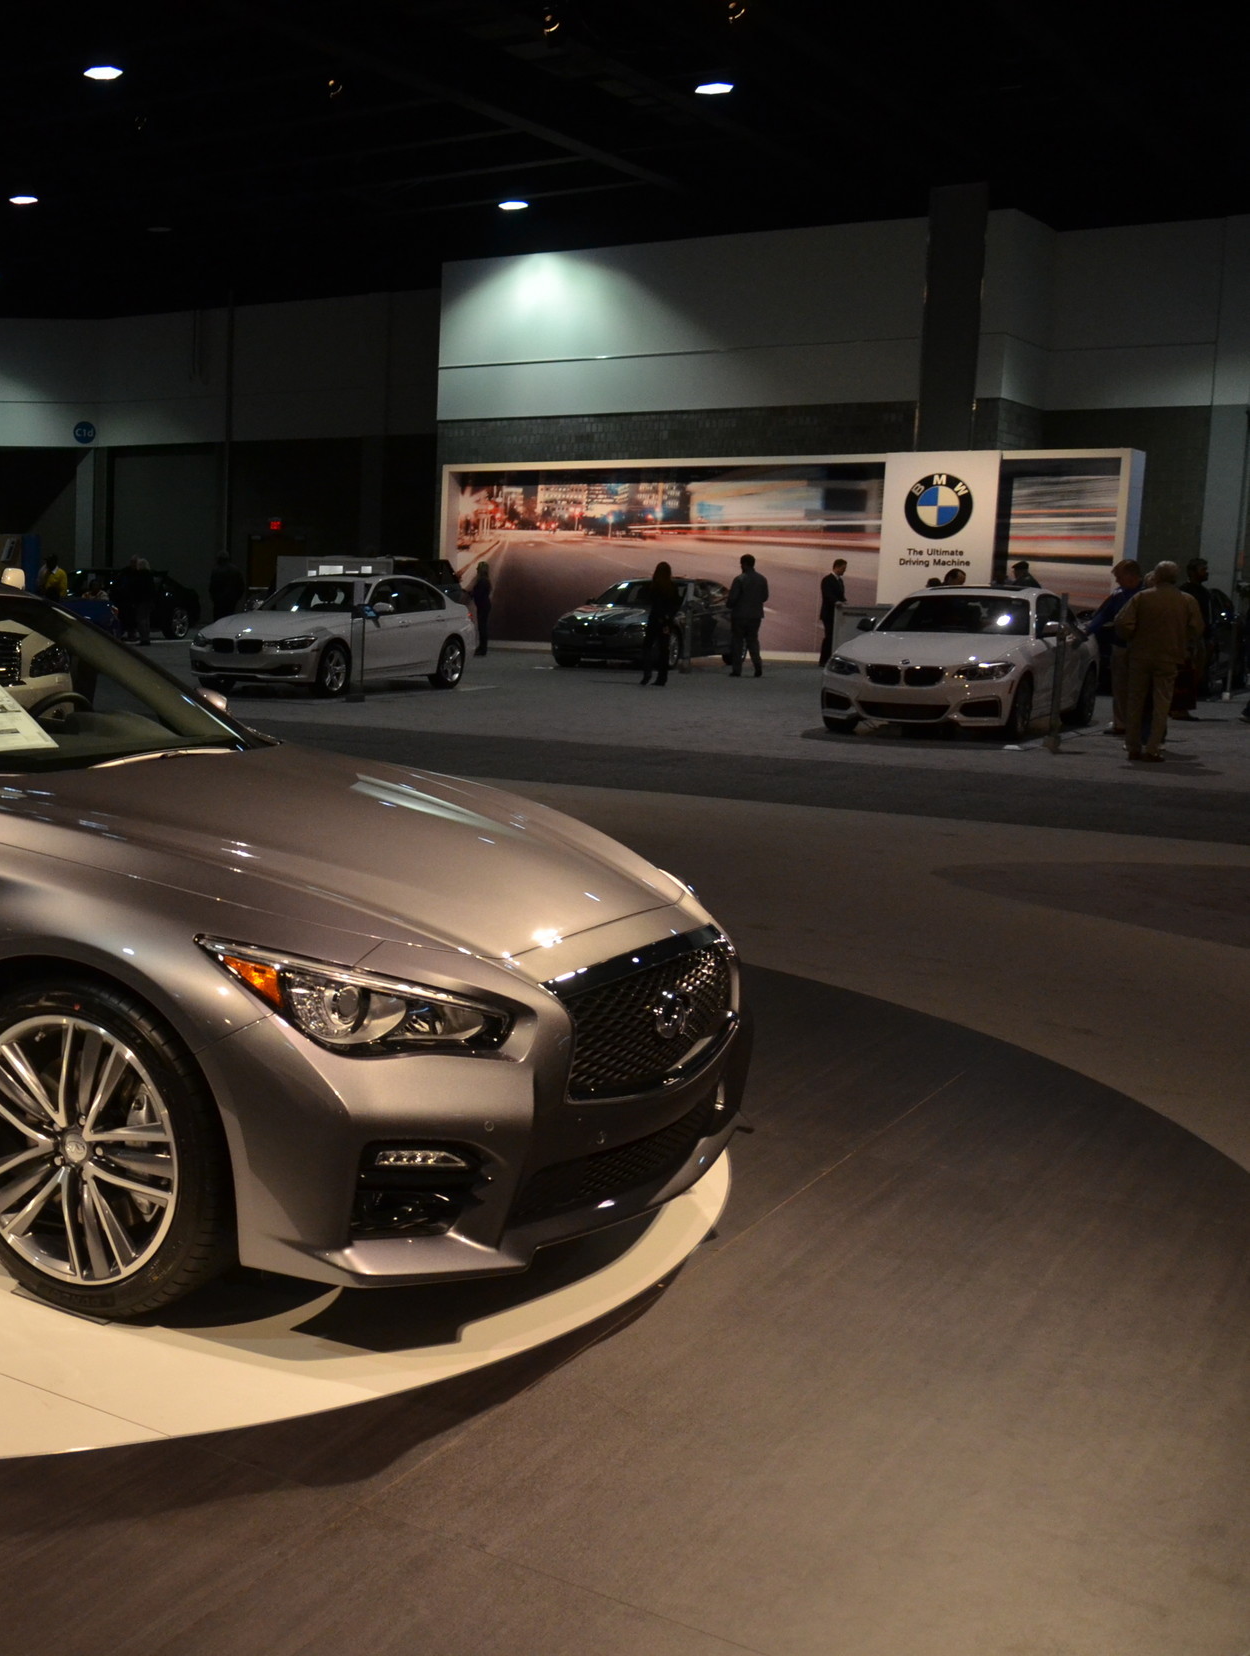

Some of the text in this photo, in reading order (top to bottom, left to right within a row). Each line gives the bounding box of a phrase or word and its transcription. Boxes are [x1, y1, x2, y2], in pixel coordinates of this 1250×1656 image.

[911, 474, 969, 496] BMW
[899, 559, 970, 567] Driving Machine
